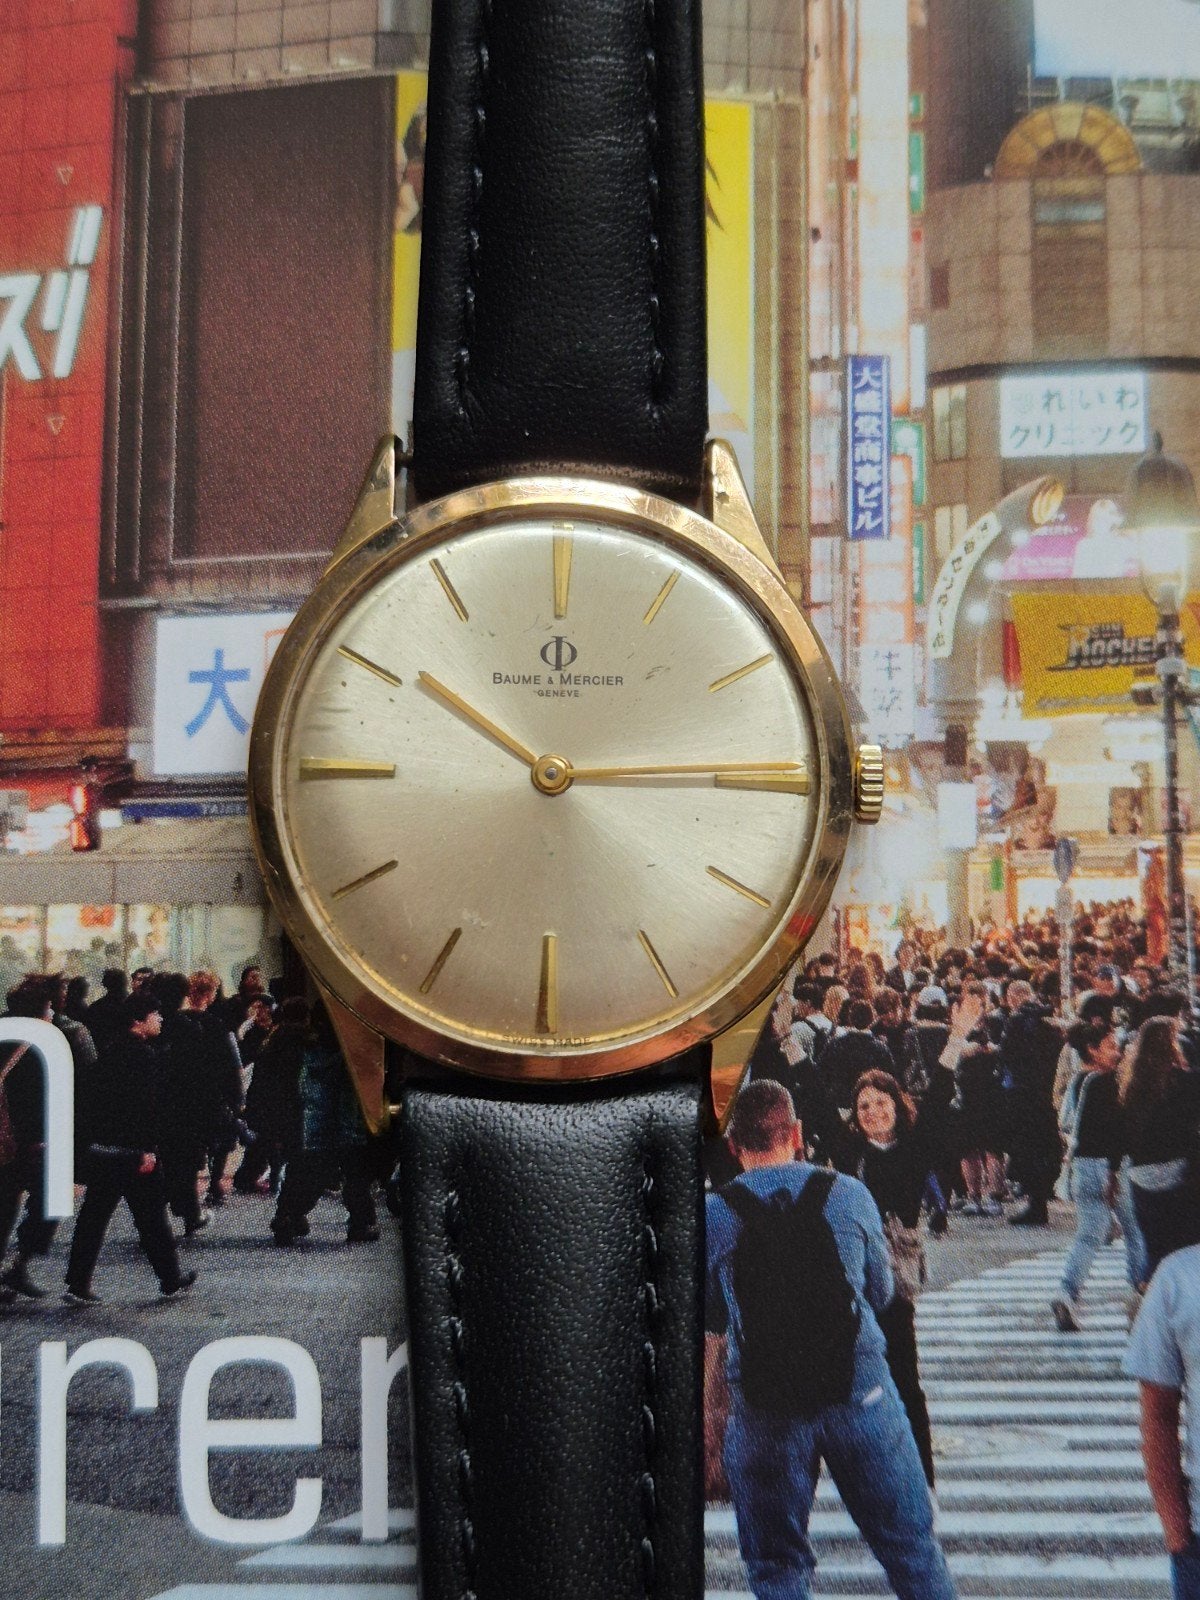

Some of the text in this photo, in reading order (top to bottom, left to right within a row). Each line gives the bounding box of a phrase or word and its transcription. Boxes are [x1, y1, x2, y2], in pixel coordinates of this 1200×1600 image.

[492, 672, 624, 686] BAUME & MERCIER
[185, 648, 250, 738] 大
[537, 690, 580, 698] GENEVE
